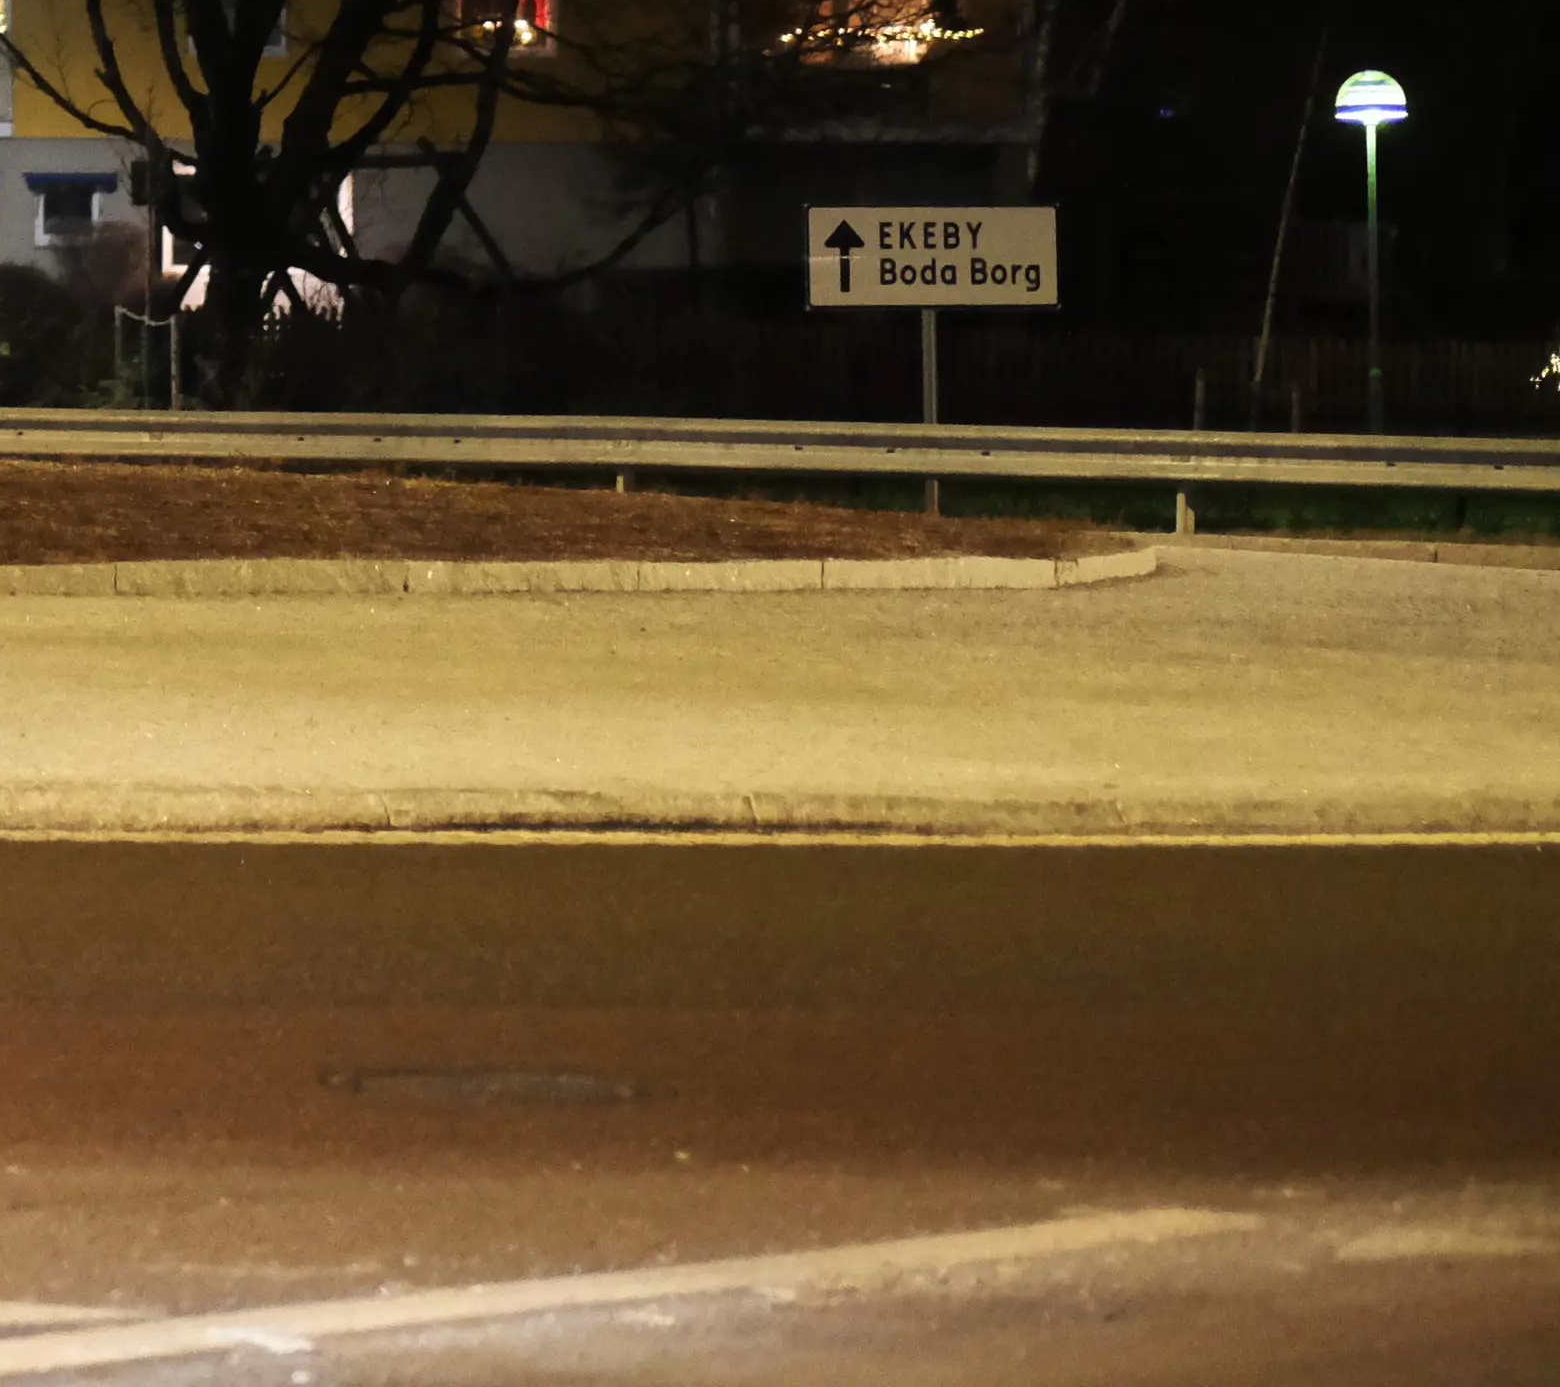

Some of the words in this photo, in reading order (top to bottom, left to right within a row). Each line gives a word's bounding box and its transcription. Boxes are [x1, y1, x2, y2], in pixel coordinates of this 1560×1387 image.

[879, 221, 983, 250] EKEBY
[879, 257, 957, 286] Boda
[970, 257, 1041, 292] Borg
